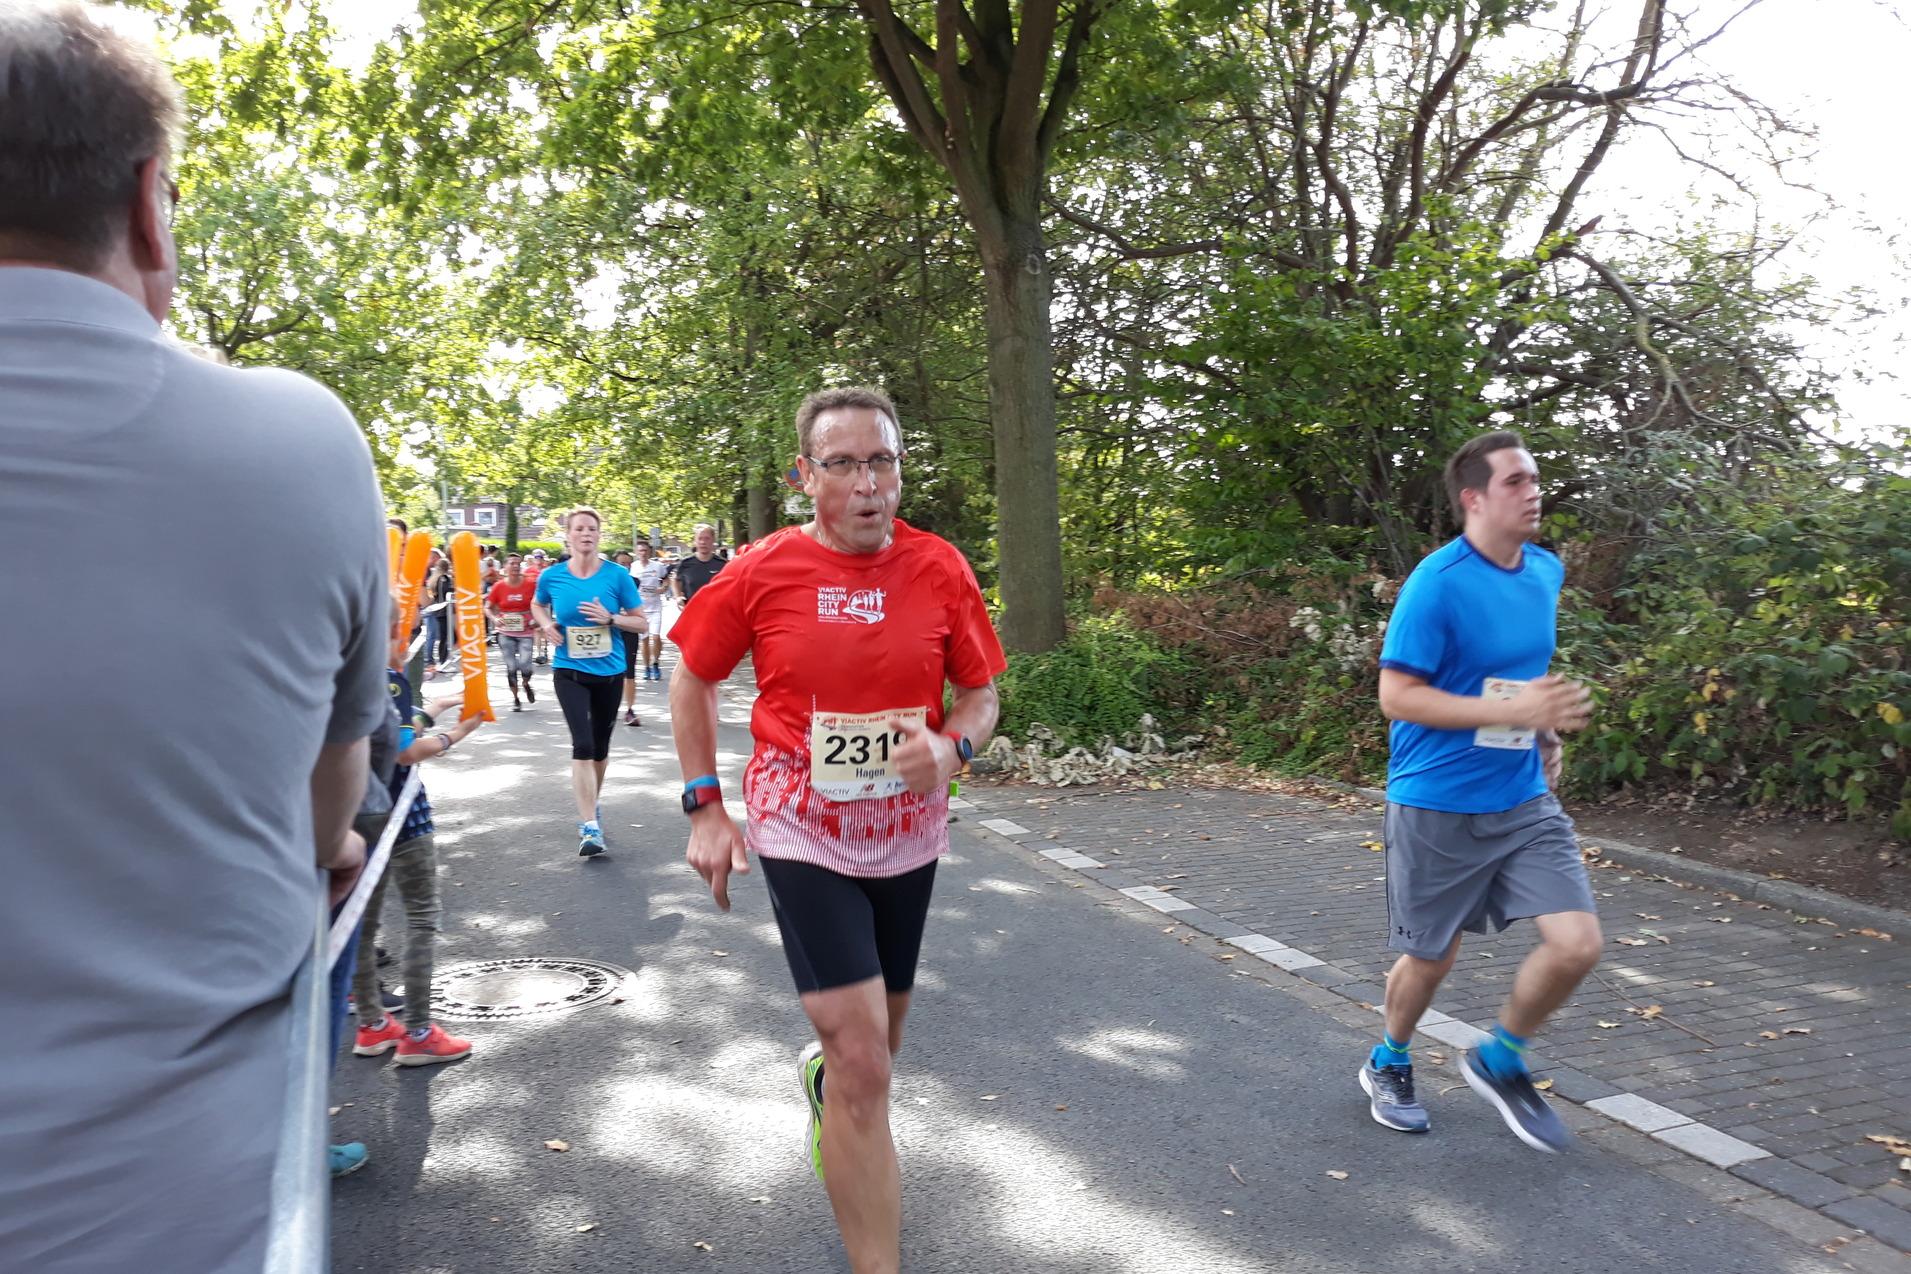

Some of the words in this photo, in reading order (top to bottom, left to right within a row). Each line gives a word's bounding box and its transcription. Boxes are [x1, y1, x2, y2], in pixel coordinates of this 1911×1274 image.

[817, 593, 847, 601] RHEIN
[817, 601, 840, 609] CITY
[817, 608, 839, 616] RUN
[457, 587, 483, 681] VIACTIV
[575, 634, 601, 646] 927
[855, 767, 885, 779] Hagen
